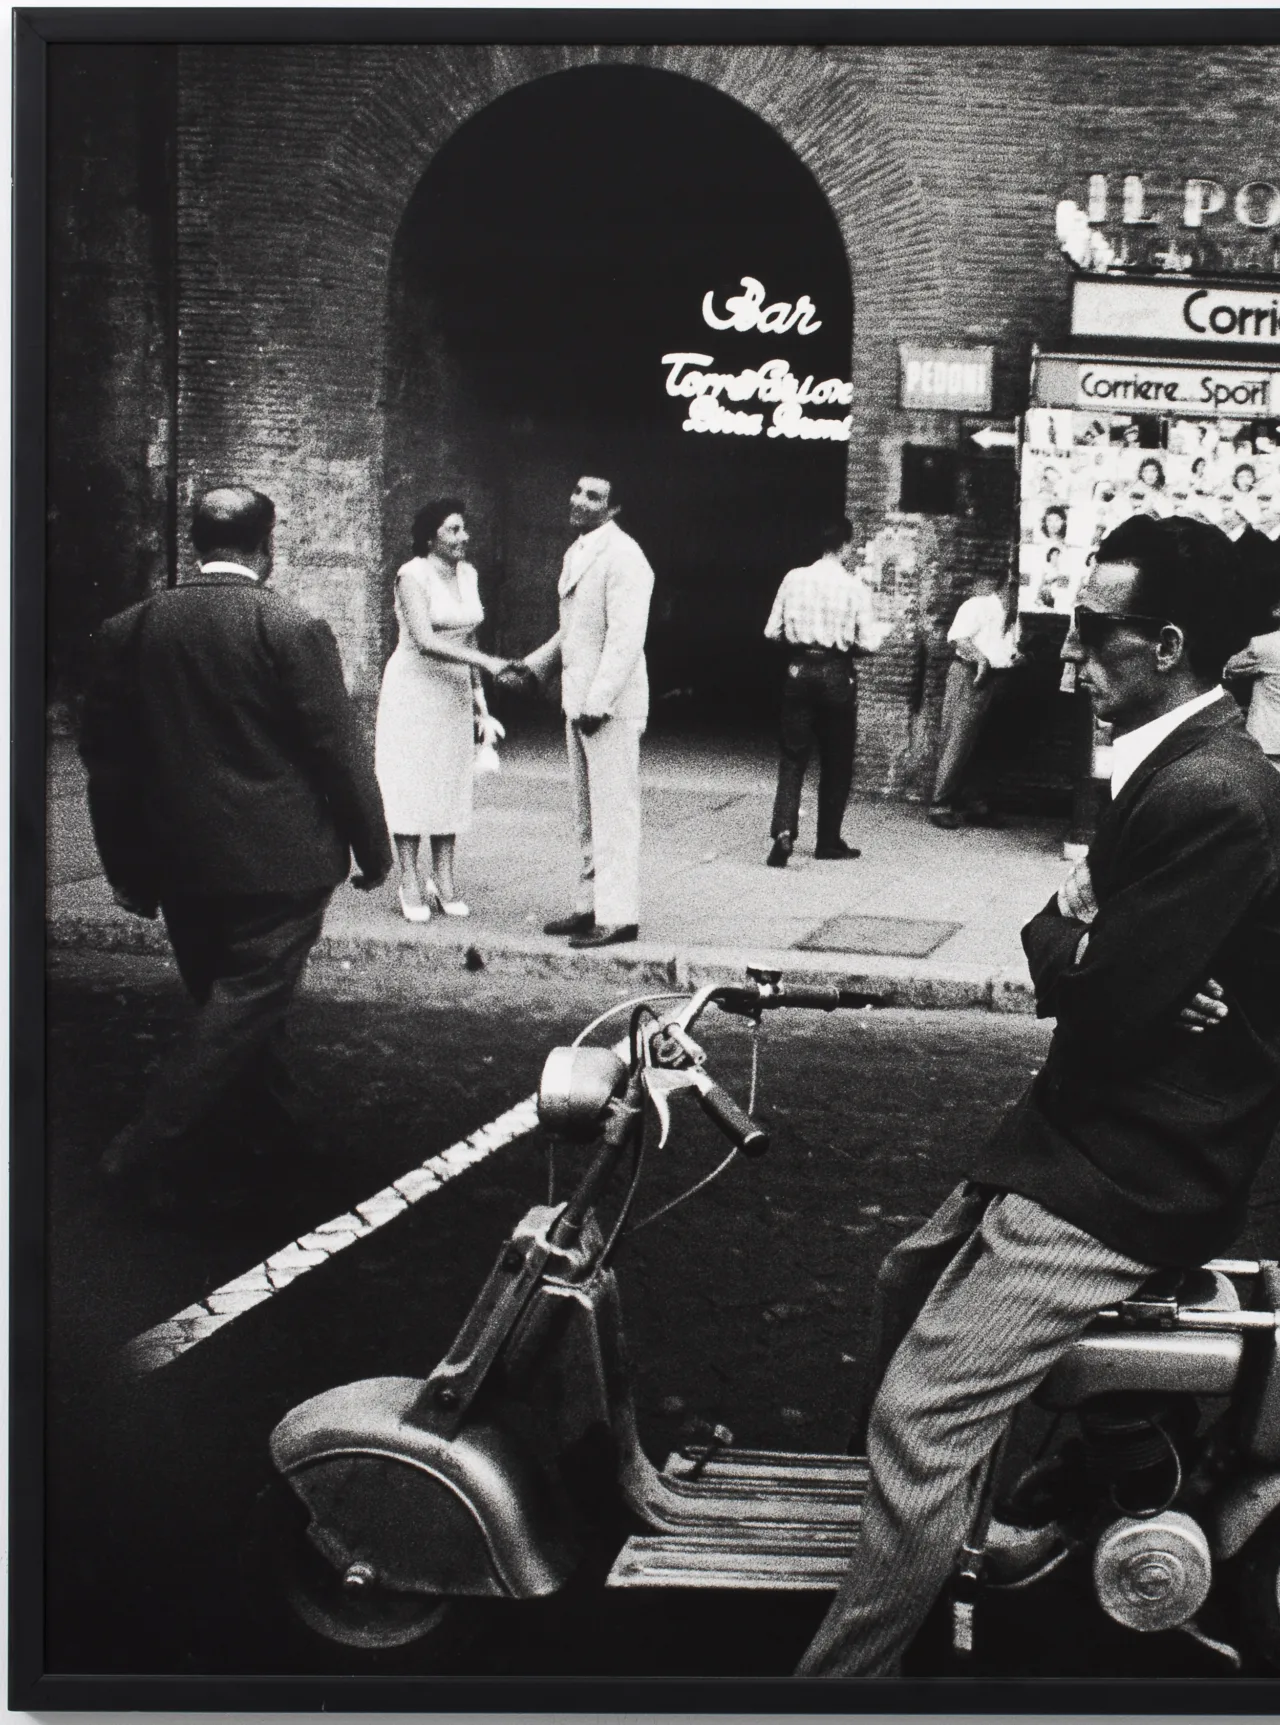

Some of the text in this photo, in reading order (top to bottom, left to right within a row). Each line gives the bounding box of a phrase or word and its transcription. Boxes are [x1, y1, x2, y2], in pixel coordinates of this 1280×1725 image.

[1088, 173, 1159, 225] IL
[701, 275, 823, 336] Bar
[1080, 371, 1271, 409] Corriere Sport
